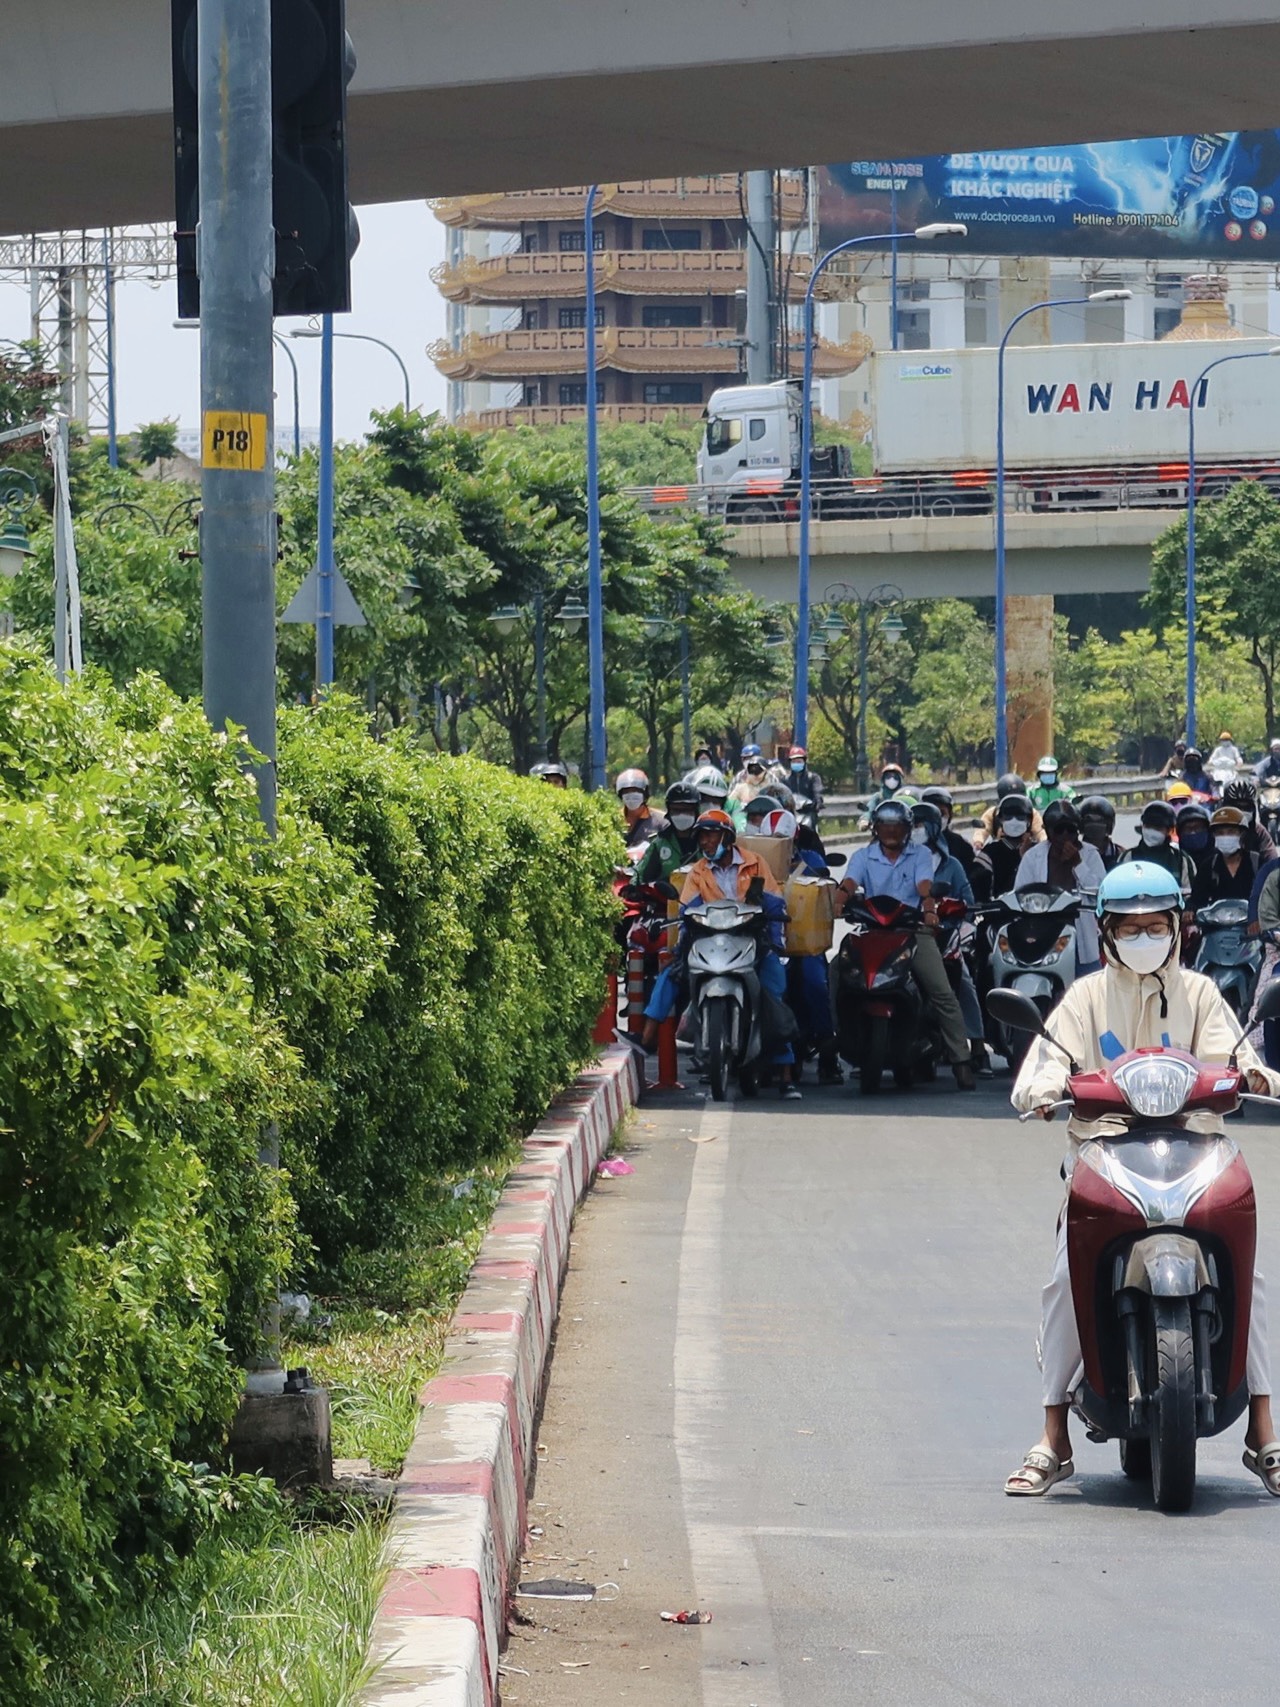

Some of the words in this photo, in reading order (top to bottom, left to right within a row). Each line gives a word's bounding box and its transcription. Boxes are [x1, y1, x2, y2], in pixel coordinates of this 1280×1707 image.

[851, 161, 924, 177] SEAHORSE
[866, 178, 908, 190] ENERGY
[954, 211, 1056, 223] www.doctorocean.vn
[1073, 213, 1115, 226] Hotline:
[1026, 382, 1113, 414] WAN
[1134, 378, 1209, 411] HAI
[212, 429, 249, 451] P18
